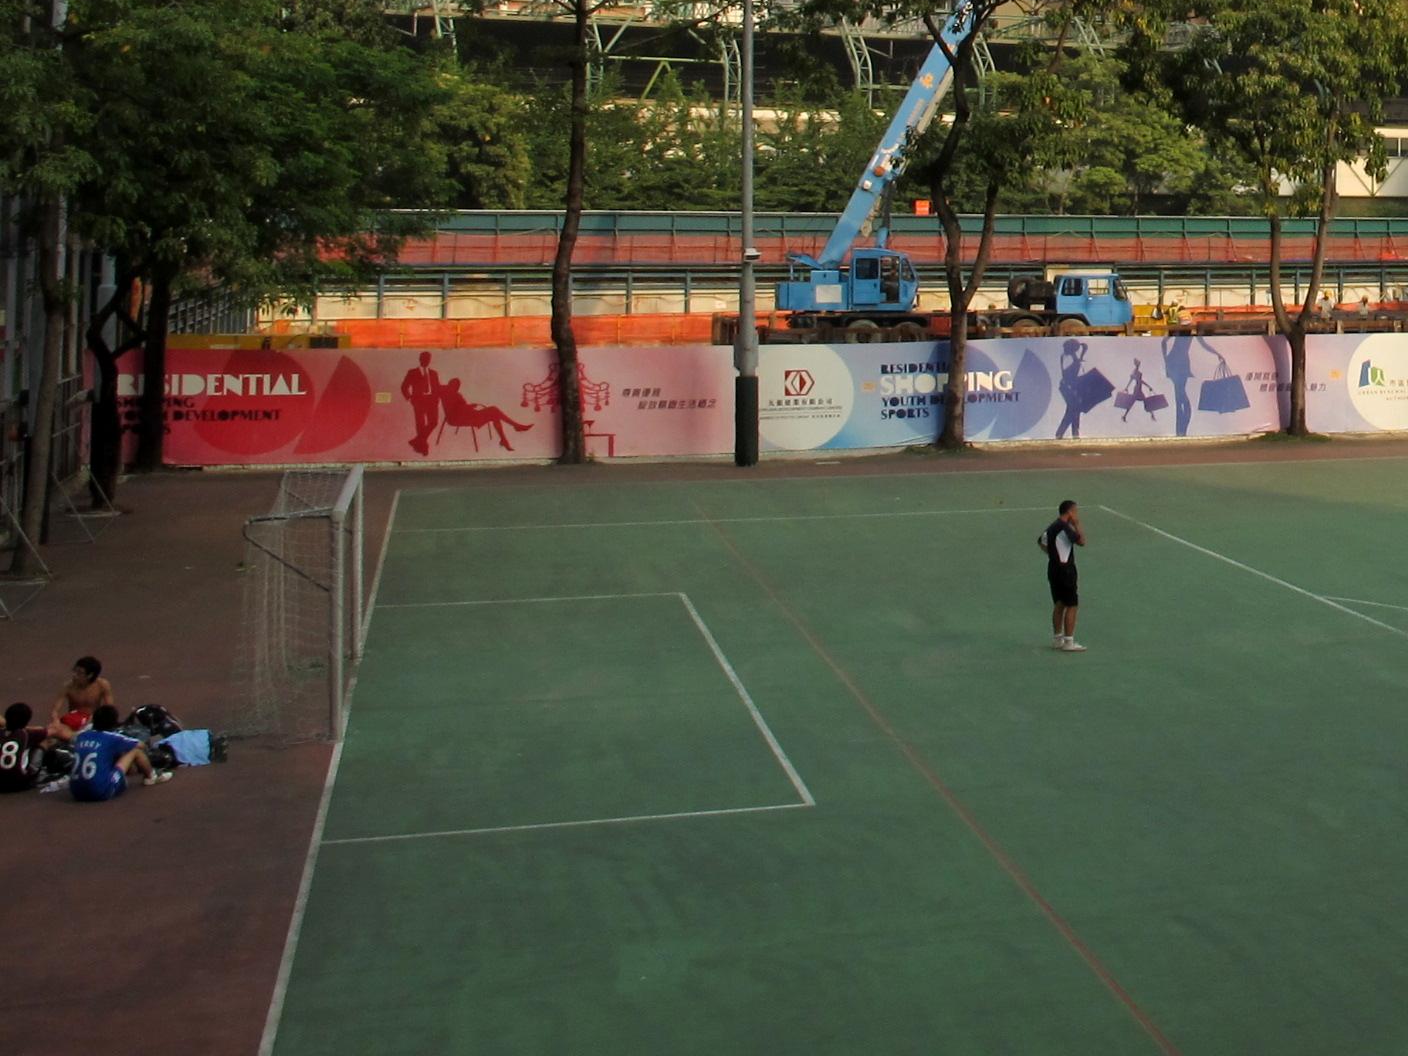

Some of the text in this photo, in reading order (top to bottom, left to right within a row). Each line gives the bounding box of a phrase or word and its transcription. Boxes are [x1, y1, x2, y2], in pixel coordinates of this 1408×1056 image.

[881, 362, 949, 374] RESIDENTI
[881, 392, 1021, 407] YOUTH DEOPMENT
[173, 409, 283, 422] DEVELOPMENT
[881, 408, 930, 420] SPORTS
[70, 752, 98, 780] 26
